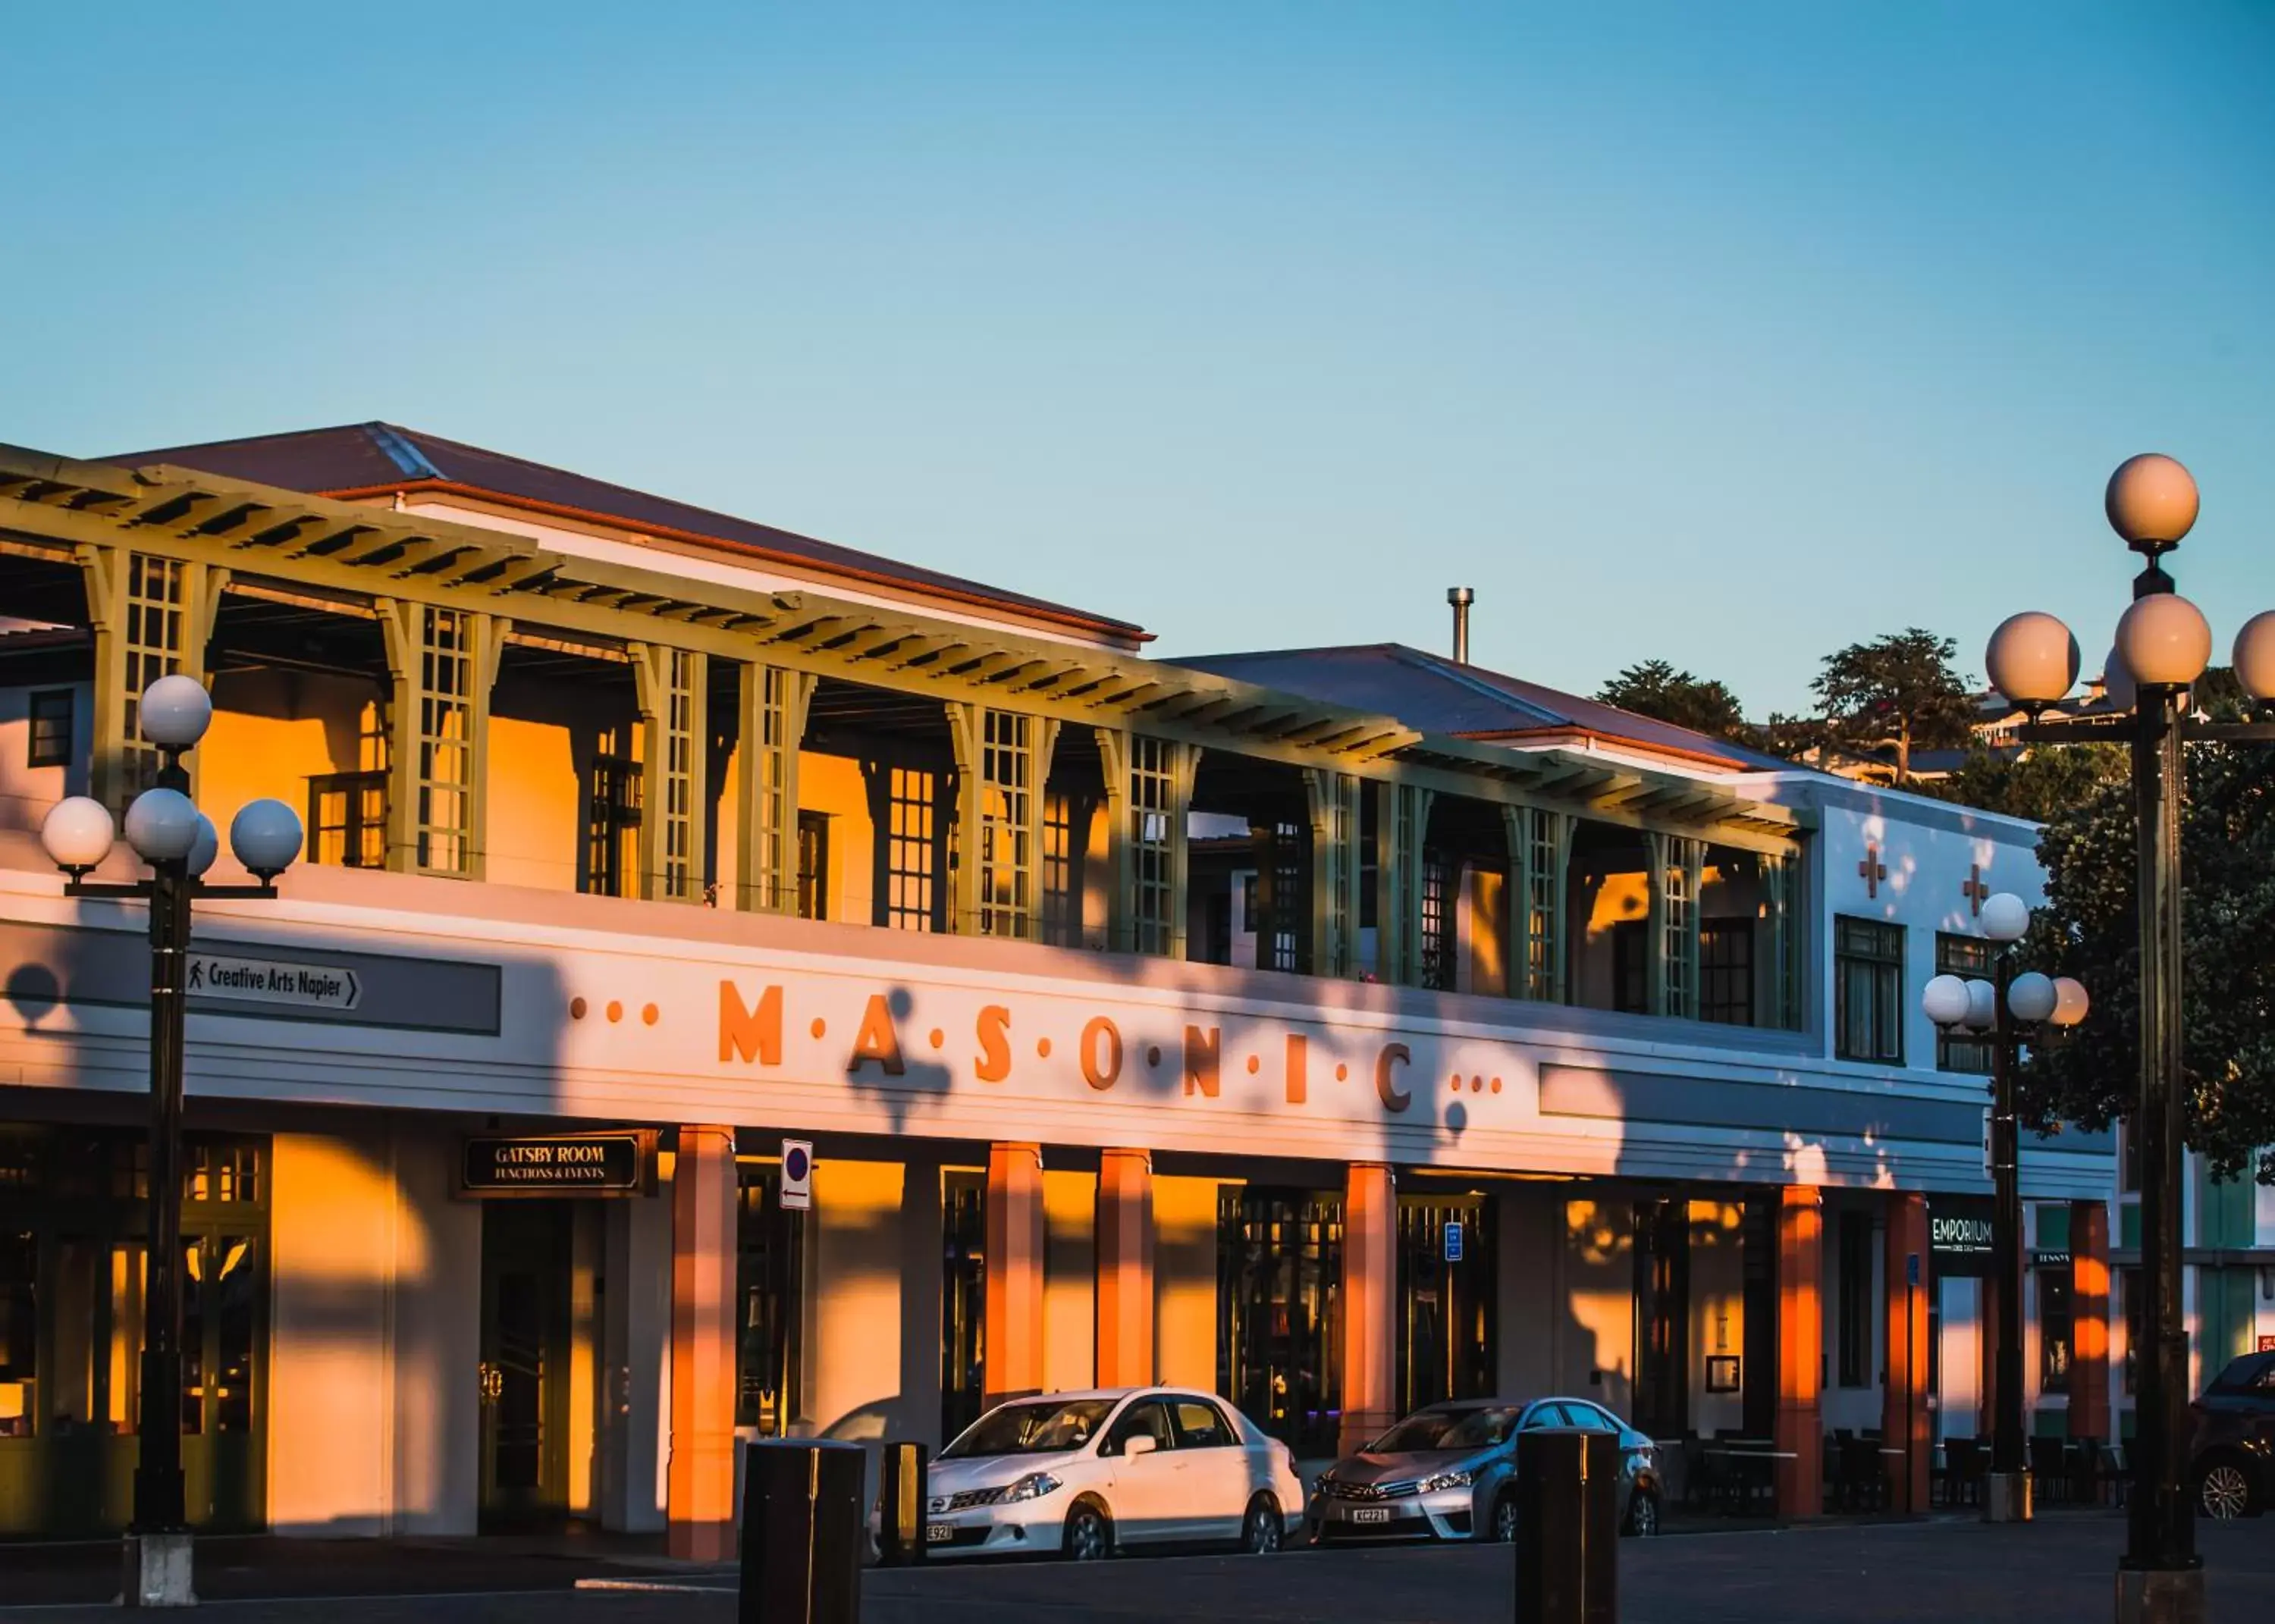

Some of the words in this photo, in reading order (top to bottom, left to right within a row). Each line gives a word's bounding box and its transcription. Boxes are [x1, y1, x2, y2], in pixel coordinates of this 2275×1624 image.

[209, 962, 265, 989] Creative
[267, 968, 294, 993] Arts
[298, 971, 340, 1001] Napier
[494, 1146, 554, 1163] GATSBY
[557, 1146, 605, 1163] ROOM
[494, 1167, 554, 1179] FUNCTIONS
[554, 1168, 563, 1179] &
[564, 1167, 605, 1179] EVENTS
[1932, 1218, 1993, 1243] EMPORIUM
